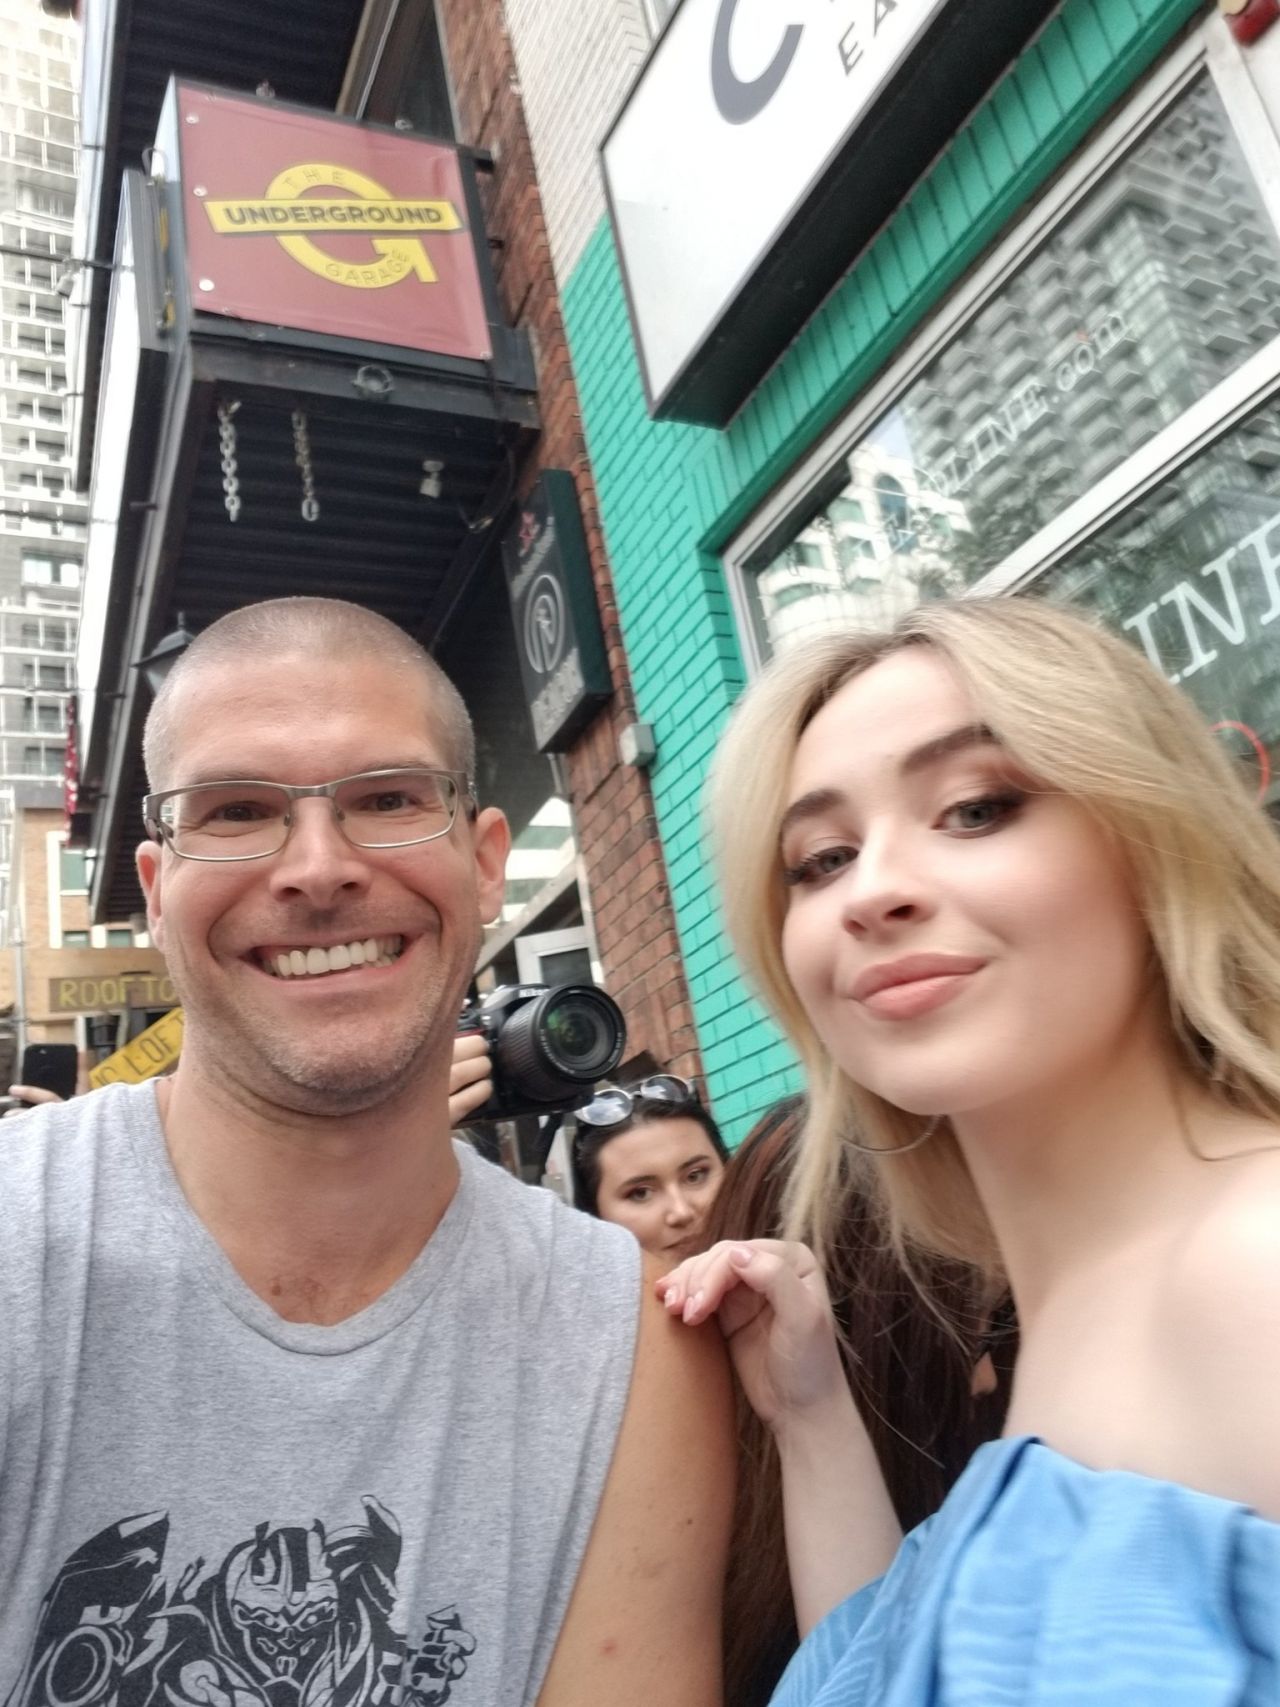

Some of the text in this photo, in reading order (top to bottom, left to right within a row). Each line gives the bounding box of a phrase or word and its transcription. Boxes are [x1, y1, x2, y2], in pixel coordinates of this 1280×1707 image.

[283, 167, 347, 189] THE
[224, 205, 443, 226] UNDERGROUND
[325, 248, 410, 286] GARAGE
